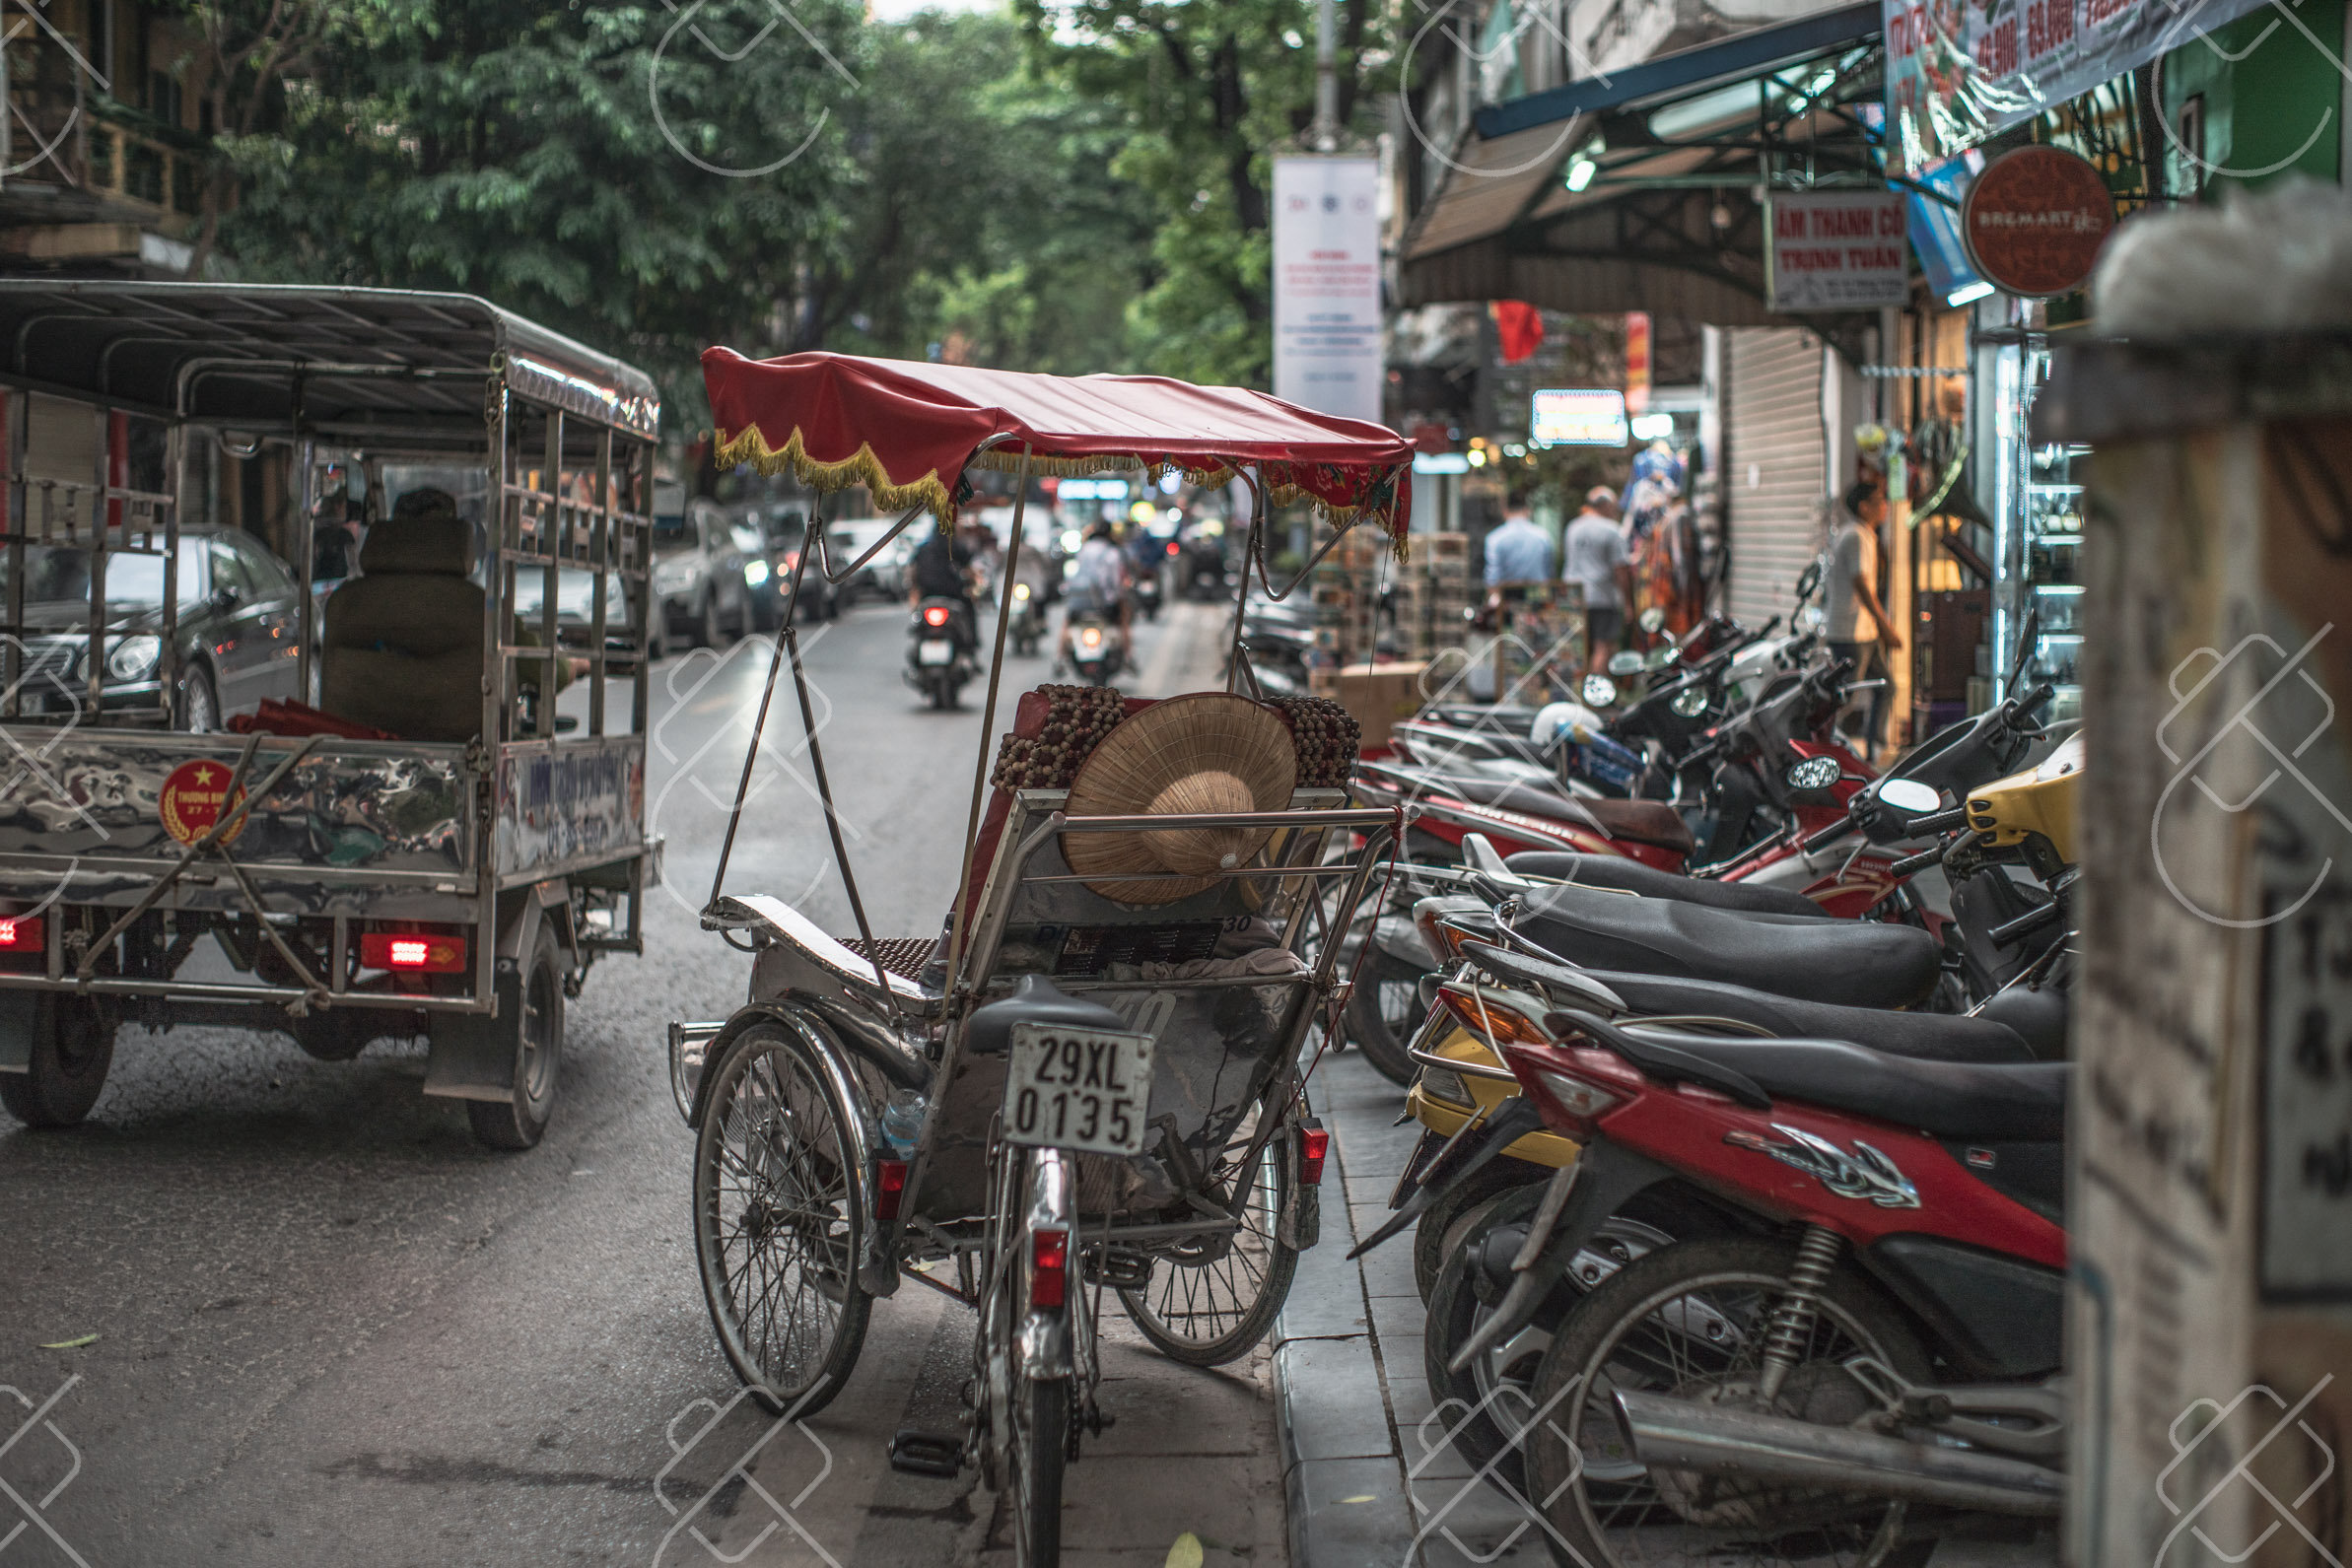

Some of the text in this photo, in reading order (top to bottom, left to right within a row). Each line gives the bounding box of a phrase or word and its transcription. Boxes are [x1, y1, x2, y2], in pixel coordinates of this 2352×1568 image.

[1811, 208, 1873, 238] THANH
[1036, 1037, 1127, 1092] 29XL
[1016, 1087, 1133, 1144] 0135
